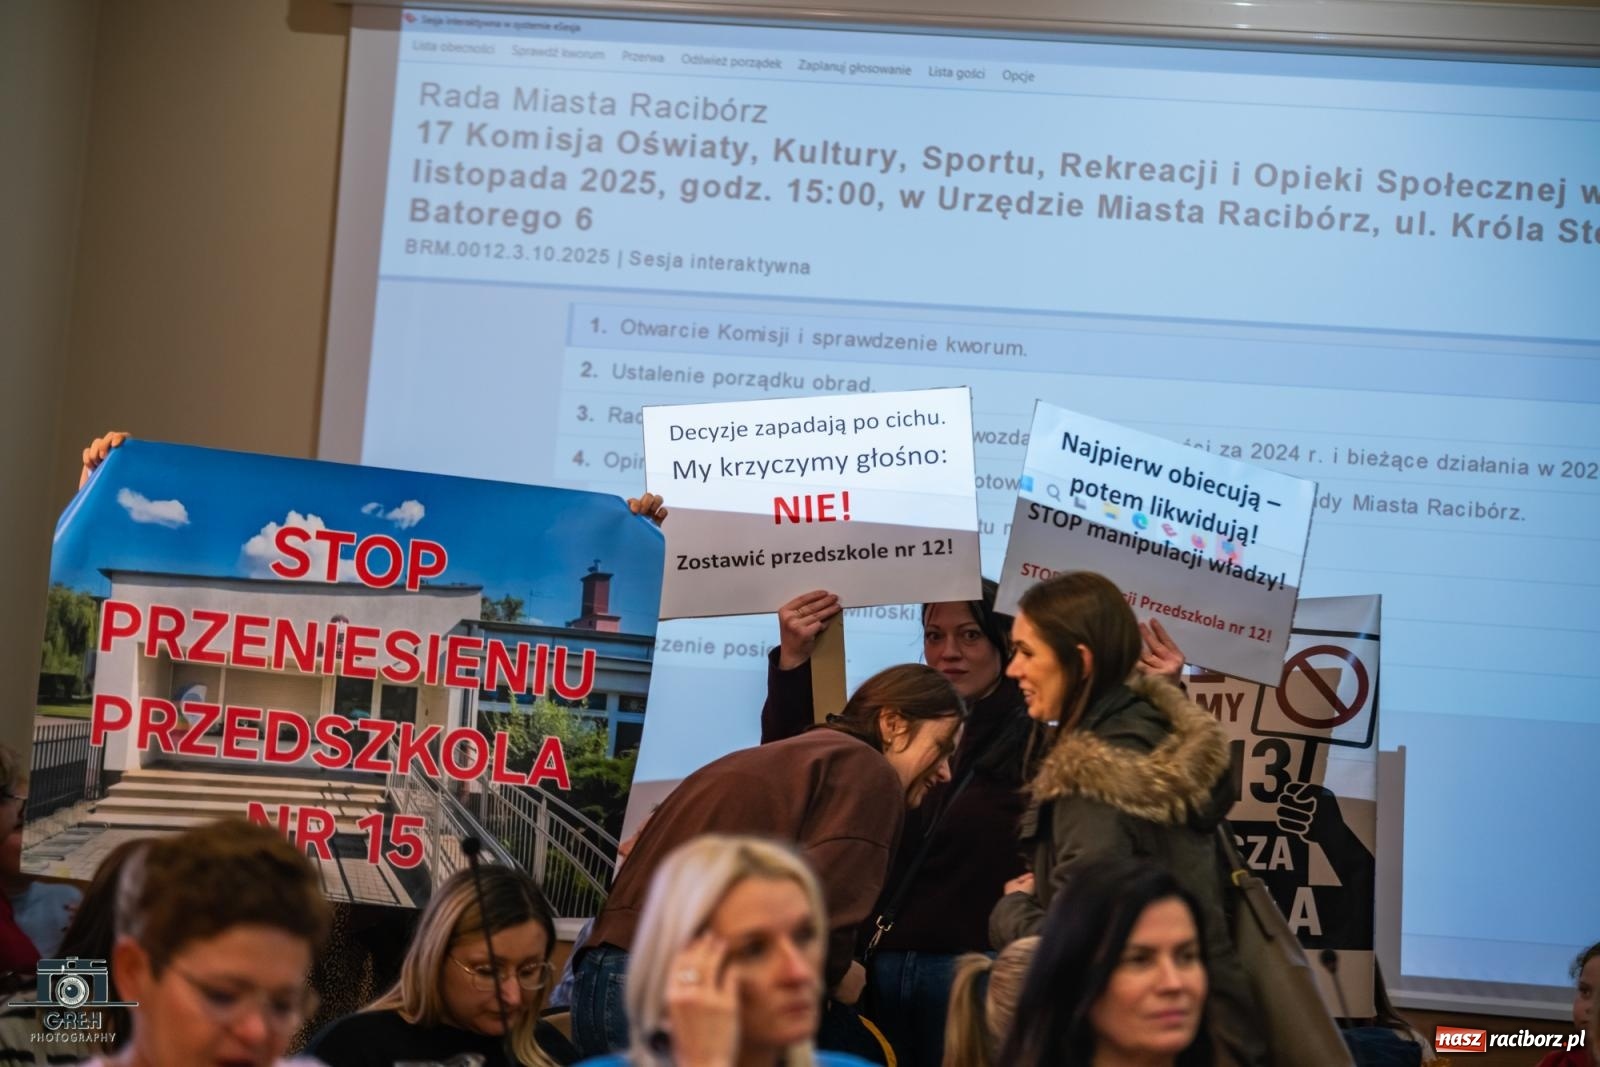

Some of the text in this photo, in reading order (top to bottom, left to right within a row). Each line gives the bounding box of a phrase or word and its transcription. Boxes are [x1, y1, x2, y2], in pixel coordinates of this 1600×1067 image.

[797, 58, 847, 74] Zaplanuj
[849, 61, 913, 76] głosowanie
[928, 65, 954, 78] Lista
[955, 67, 986, 81] gości
[1002, 69, 1036, 84] Opcje
[419, 82, 768, 124] Rada Miasta Racibórz
[417, 120, 1600, 209] 17 Komisja Oświaty, Kultury, Sportu, Rekreacji i Opieki Społecznej w
[409, 197, 594, 235] Batorego 6
[412, 158, 568, 193] listopada
[579, 167, 665, 199] 2025,
[679, 175, 772, 204] godz.
[787, 178, 885, 211] 15:00,
[899, 187, 926, 209] w
[938, 185, 1084, 220] Urzędzie
[1097, 193, 1204, 225] Miasta
[1218, 199, 1380, 238] Racibórz,
[1395, 210, 1436, 237] ul.
[1451, 211, 1544, 242] Króla
[405, 238, 610, 265] BRM.0012.3.10.2025
[628, 250, 683, 272] Sesja
[689, 254, 812, 277] interaktywna
[590, 317, 1028, 357] 1. Otwarcie Komisji i sprawdzenie kworum.
[580, 361, 877, 393] 2. Ustalenie porządku obrad.
[576, 405, 594, 423] 3.
[973, 429, 1031, 446] wozda
[1219, 443, 1243, 459] za
[1250, 442, 1301, 462] 2024
[1308, 449, 1323, 464] r.
[1332, 447, 1338, 464] i
[1347, 448, 1429, 472] bieżące
[1436, 454, 1530, 476] działania
[1537, 462, 1554, 477] w
[1560, 460, 1600, 481] 202
[669, 409, 946, 443] Decyzje zapadają po cichu.
[572, 449, 591, 467] 4.
[975, 473, 1020, 491] otow
[1314, 493, 1343, 513] dy
[1353, 493, 1418, 515] Miasta
[1427, 498, 1527, 522] Racibórz.
[672, 445, 948, 483] My krzyczymy głośno:
[1061, 431, 1163, 478] Najpierw
[1168, 467, 1262, 512] obiecują
[773, 490, 852, 525] NIE!
[1069, 477, 1259, 547] potem likwidują!
[270, 524, 449, 592] STOP
[676, 538, 953, 571] Zostawić przedszkole nr 12!
[1027, 502, 1286, 592] STOP manipulacji władzy!
[1139, 594, 1225, 631] Przedszkola
[1228, 621, 1245, 635] nr
[1248, 626, 1272, 643] 12!
[99, 599, 597, 701] PRZENIESIENIU
[658, 637, 716, 655] zenie
[89, 692, 572, 791] PRZEDSZKOLA
[356, 812, 426, 870] 15
